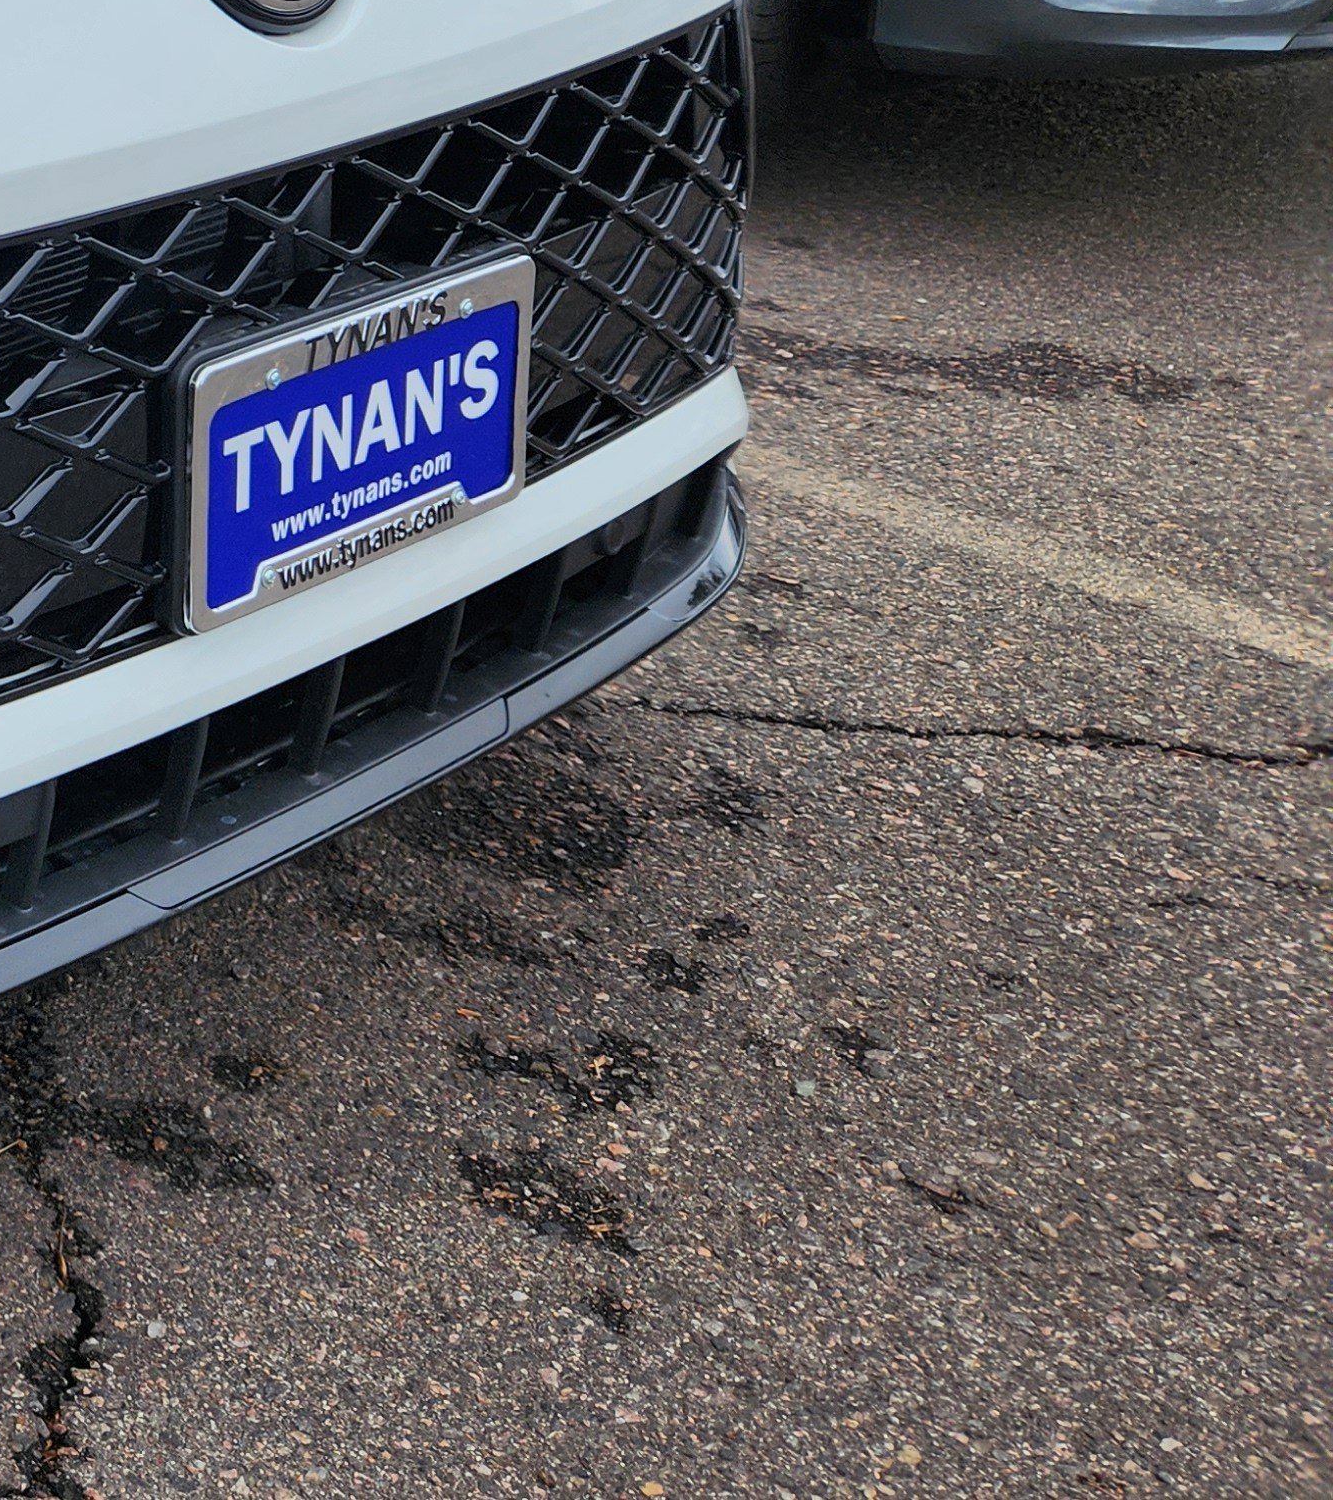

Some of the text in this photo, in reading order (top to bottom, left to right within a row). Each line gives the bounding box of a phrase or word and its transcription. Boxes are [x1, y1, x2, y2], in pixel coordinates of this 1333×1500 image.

[306, 290, 448, 373] TYNAN'S
[223, 339, 500, 514] TYNAN'S
[271, 450, 452, 542] www.tynans.com
[277, 495, 456, 590] www.tynans.com
